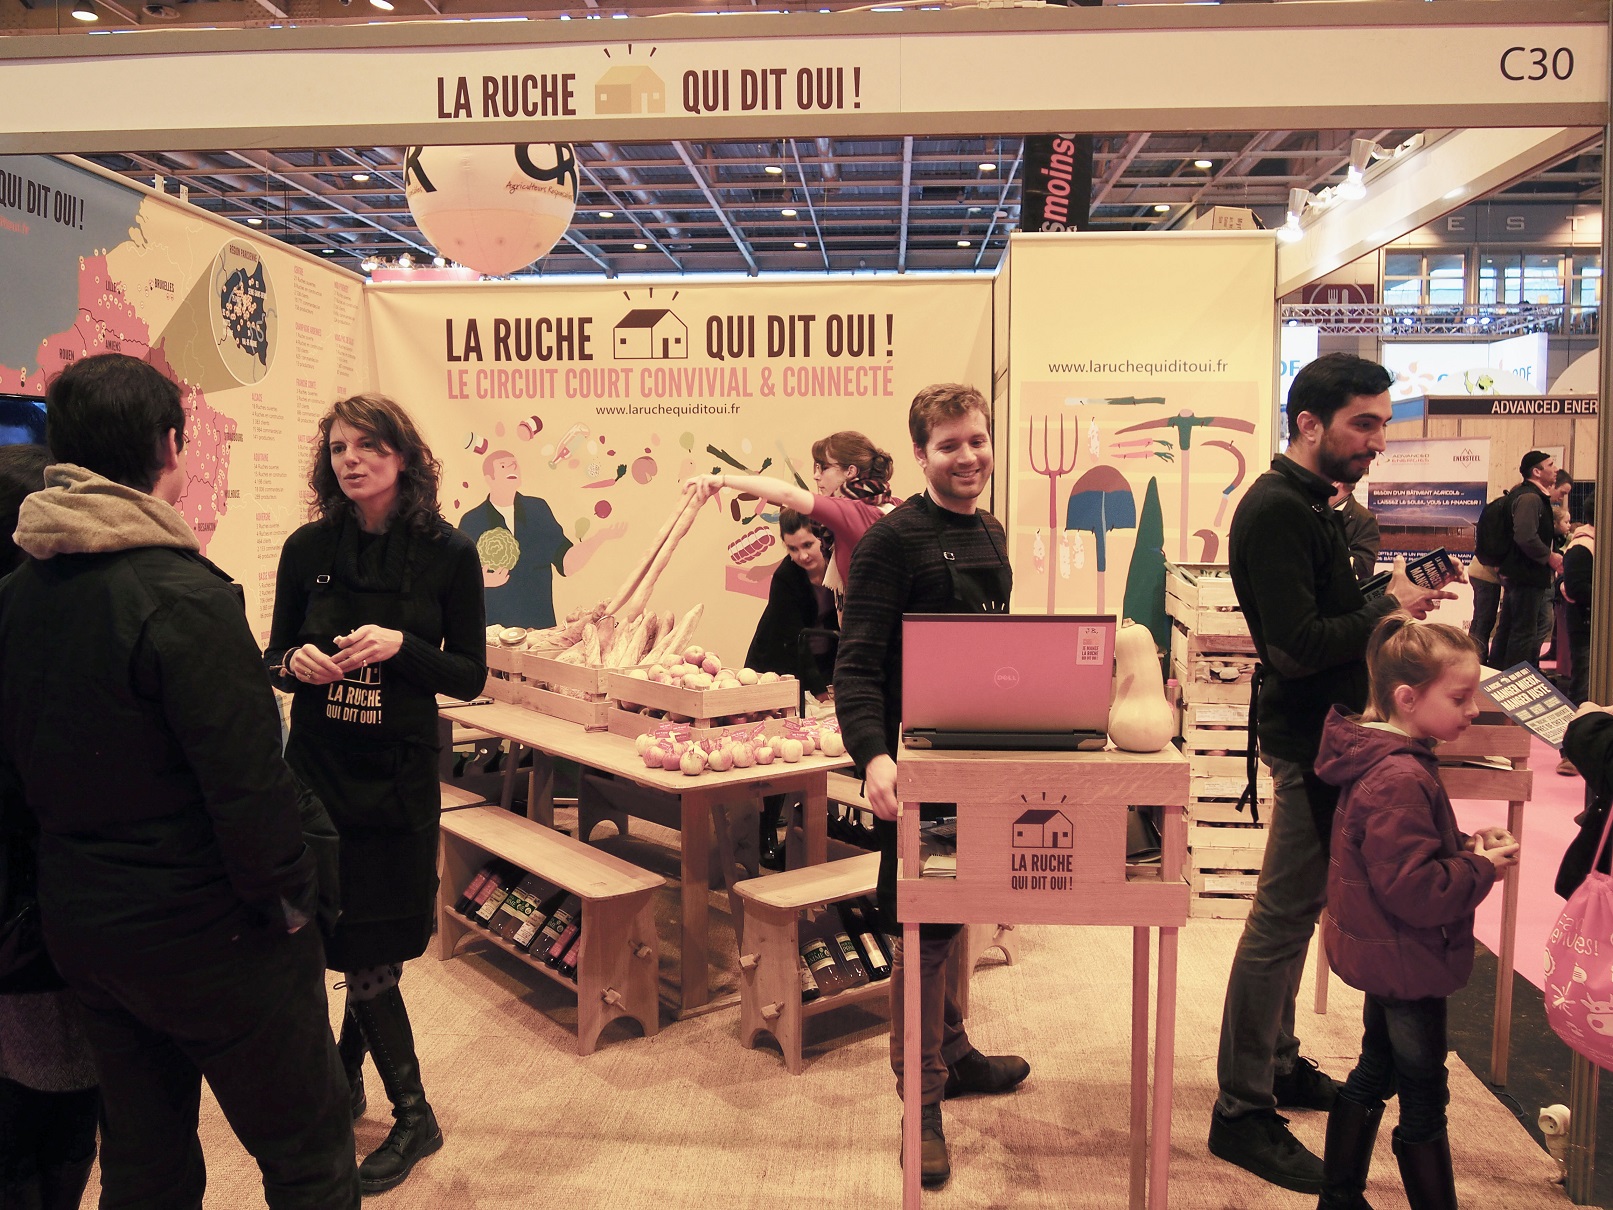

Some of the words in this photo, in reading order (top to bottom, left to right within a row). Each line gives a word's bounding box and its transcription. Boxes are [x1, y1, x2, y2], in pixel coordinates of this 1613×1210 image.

[1500, 46, 1575, 81] C30
[437, 76, 473, 118] LA
[482, 73, 578, 117] RUCHE
[682, 69, 730, 115] QUI
[740, 68, 788, 111] DIT
[27, 179, 51, 219] DIT
[105, 279, 117, 293] LILLE
[154, 278, 175, 293] BRUXELLES
[446, 319, 484, 362] LA
[494, 317, 594, 362] RUCHE
[706, 316, 755, 361] QUI
[768, 315, 816, 358] DIT
[59, 348, 75, 361] ROUEN
[1048, 359, 1229, 377] www.laruchequiditoui.fr
[446, 369, 469, 399] LE
[476, 369, 556, 399] CIRCUIT
[565, 368, 634, 398] COURT
[640, 367, 754, 398] CONVIVIAL
[760, 366, 776, 397] &
[783, 360, 894, 397] CONNECTÉ
[595, 403, 741, 418] www.laruchequiditoui.fr
[1491, 400, 1560, 414] ADVANCED
[327, 683, 344, 702] LA
[345, 686, 382, 707] RUCHE
[1490, 683, 1522, 703] MANGER
[1515, 673, 1542, 691] MIEUX
[1500, 692, 1534, 712] MANGER
[1526, 683, 1552, 700] JUSTE
[326, 703, 342, 719] QUI
[342, 706, 359, 723] DIT
[1011, 854, 1027, 872] LA
[1031, 854, 1074, 872] RUCHE
[1011, 875, 1028, 891] QUI
[1031, 875, 1048, 891] DIT
